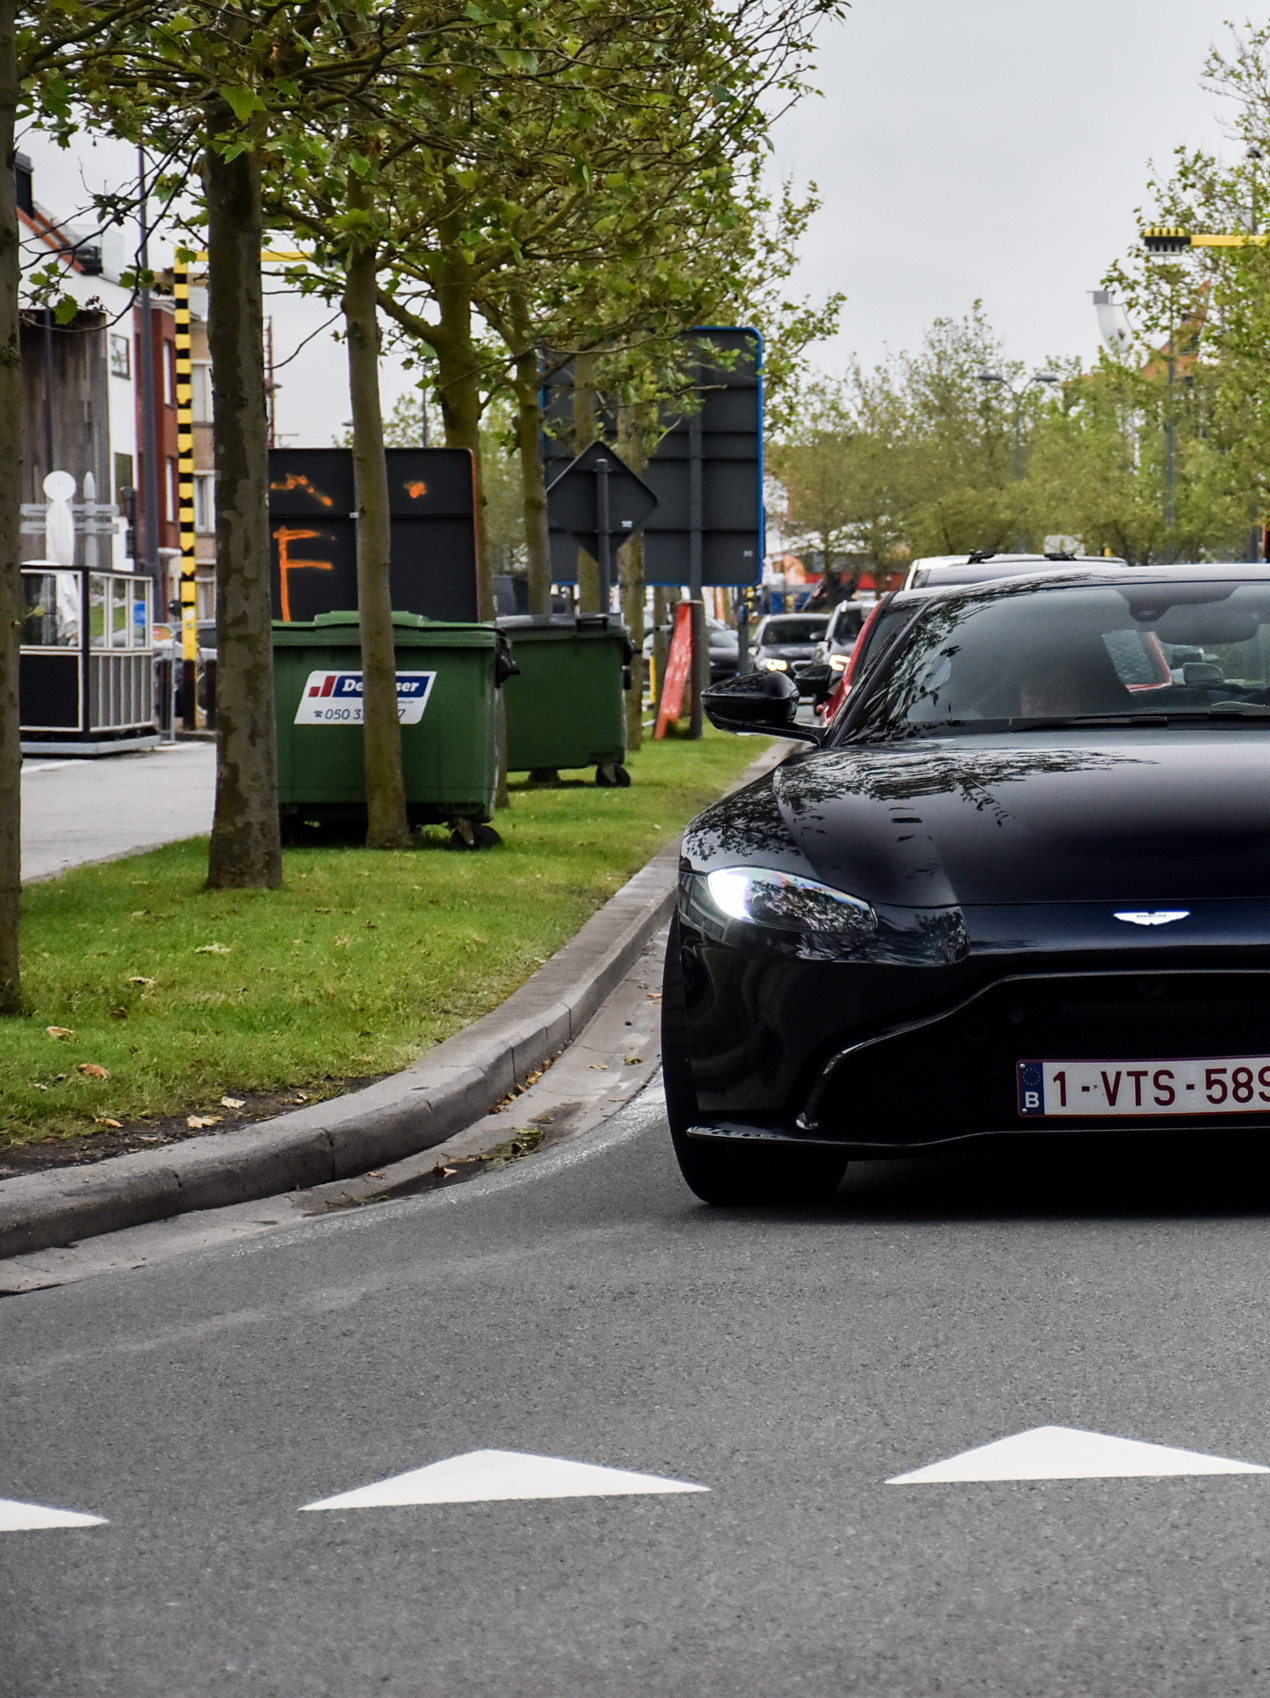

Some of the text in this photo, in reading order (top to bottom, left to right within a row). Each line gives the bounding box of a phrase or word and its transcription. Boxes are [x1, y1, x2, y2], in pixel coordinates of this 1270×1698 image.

[342, 679, 419, 692] Deser
[325, 708, 350, 720] 050
[1025, 1092, 1040, 1108] B
